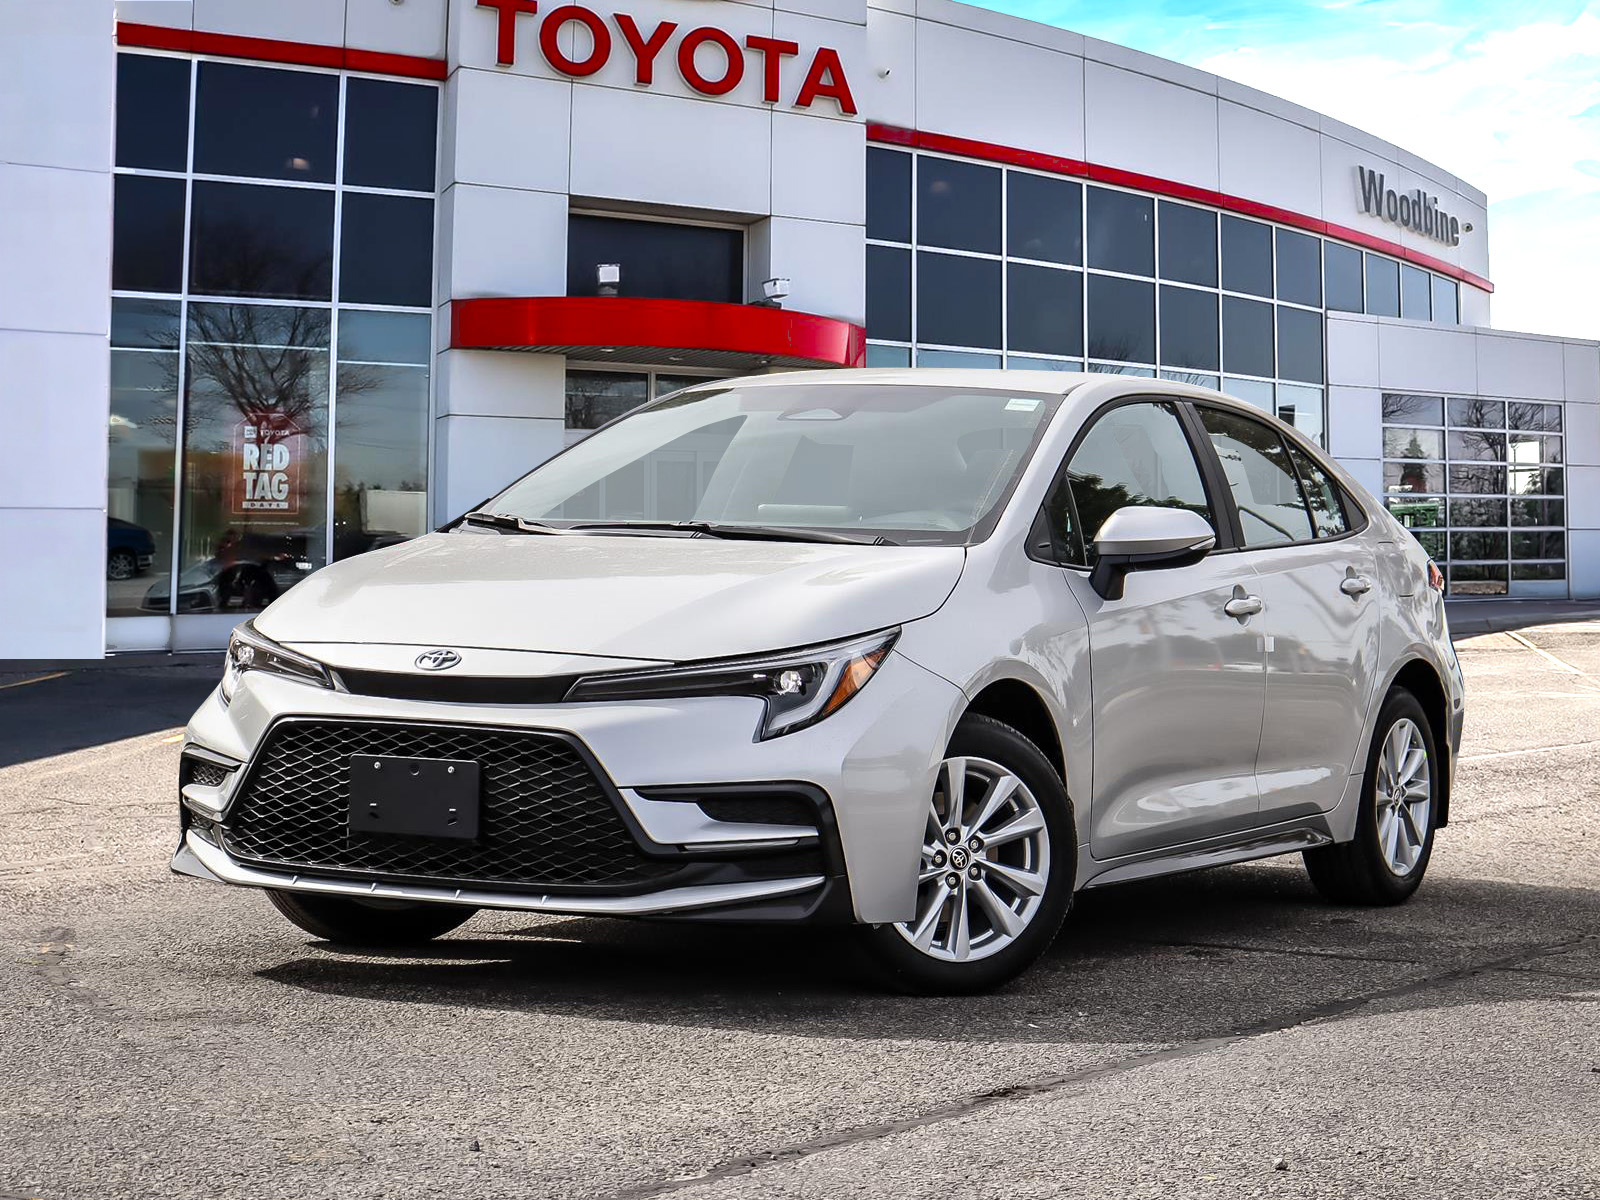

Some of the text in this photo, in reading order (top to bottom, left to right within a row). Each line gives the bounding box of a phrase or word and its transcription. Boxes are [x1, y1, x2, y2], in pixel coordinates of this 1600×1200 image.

[477, 0, 858, 116] TOYOTA
[1357, 165, 1460, 247] Woodbine
[260, 429, 290, 437] TOYOTA
[243, 443, 290, 470] RED
[243, 472, 289, 500] TAG
